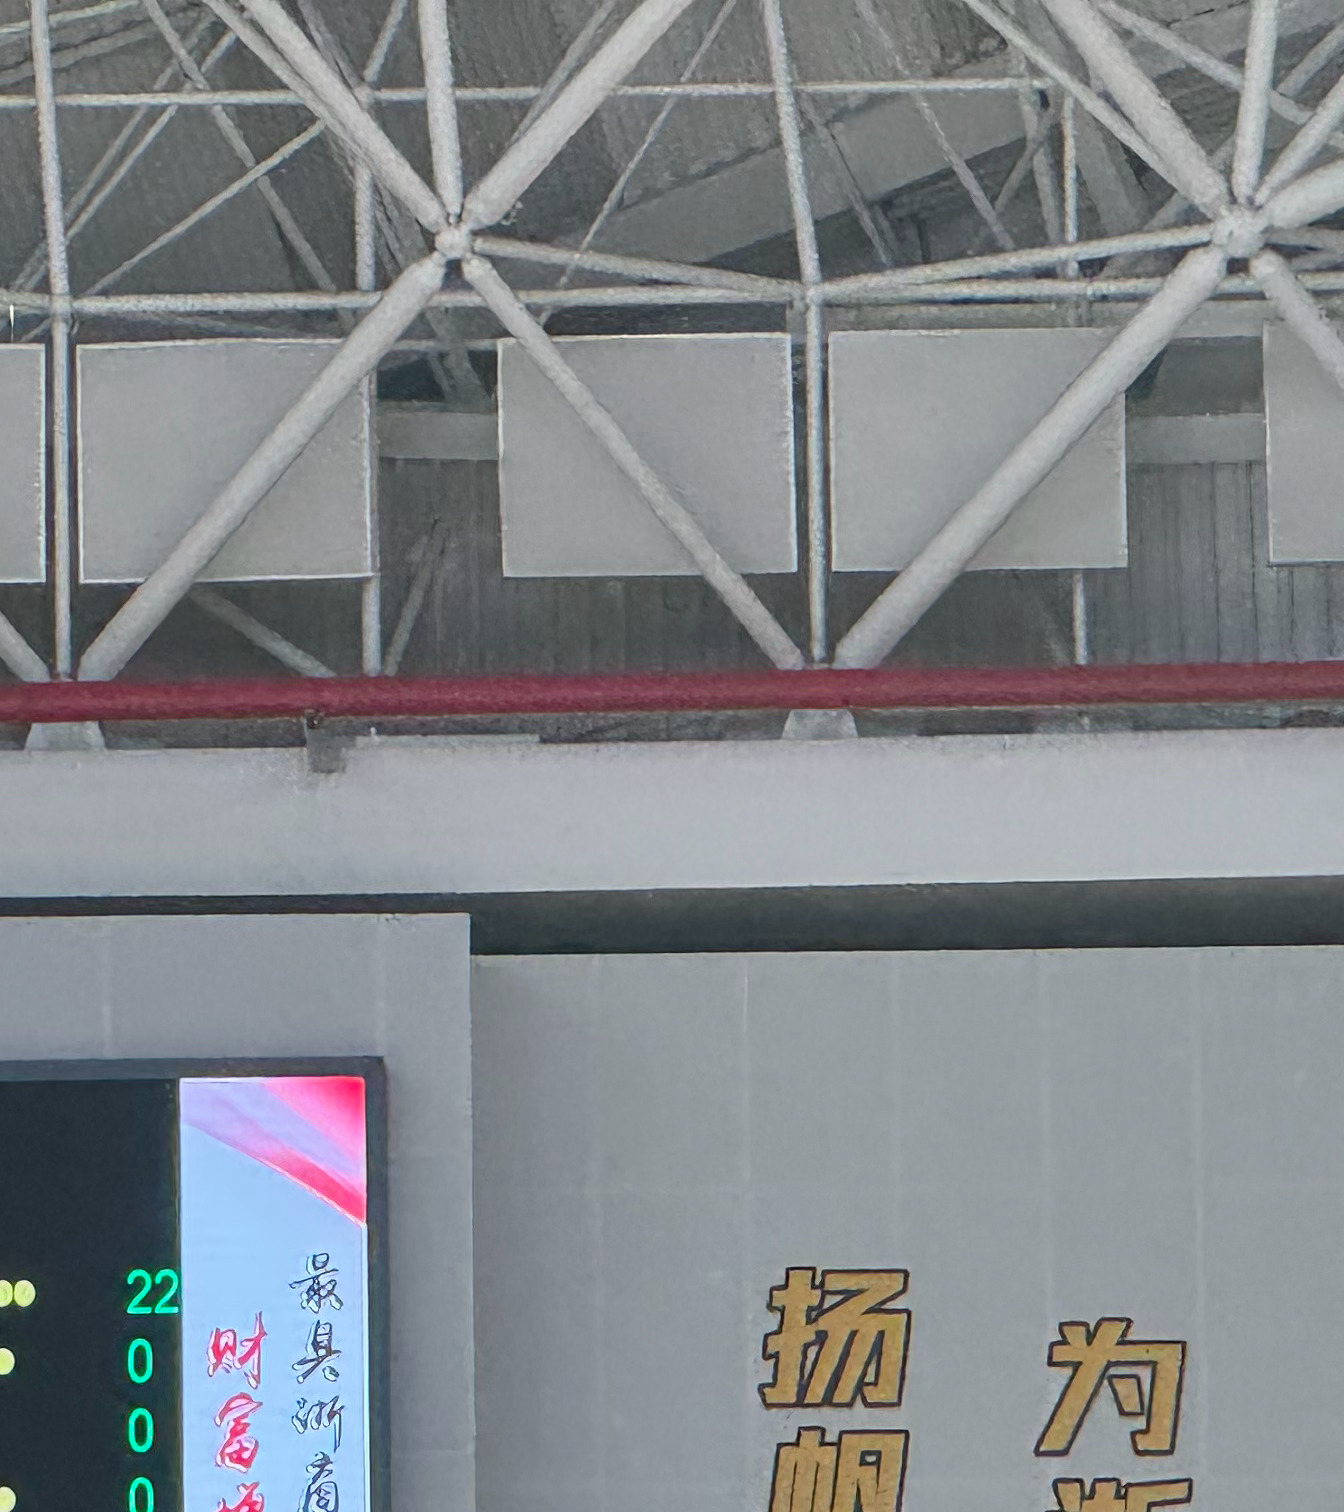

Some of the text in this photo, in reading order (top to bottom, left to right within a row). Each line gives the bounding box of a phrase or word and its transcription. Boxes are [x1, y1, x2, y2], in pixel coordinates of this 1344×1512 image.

[127, 1269, 179, 1316] 22
[128, 1338, 153, 1383] 0
[128, 1408, 153, 1452] 0
